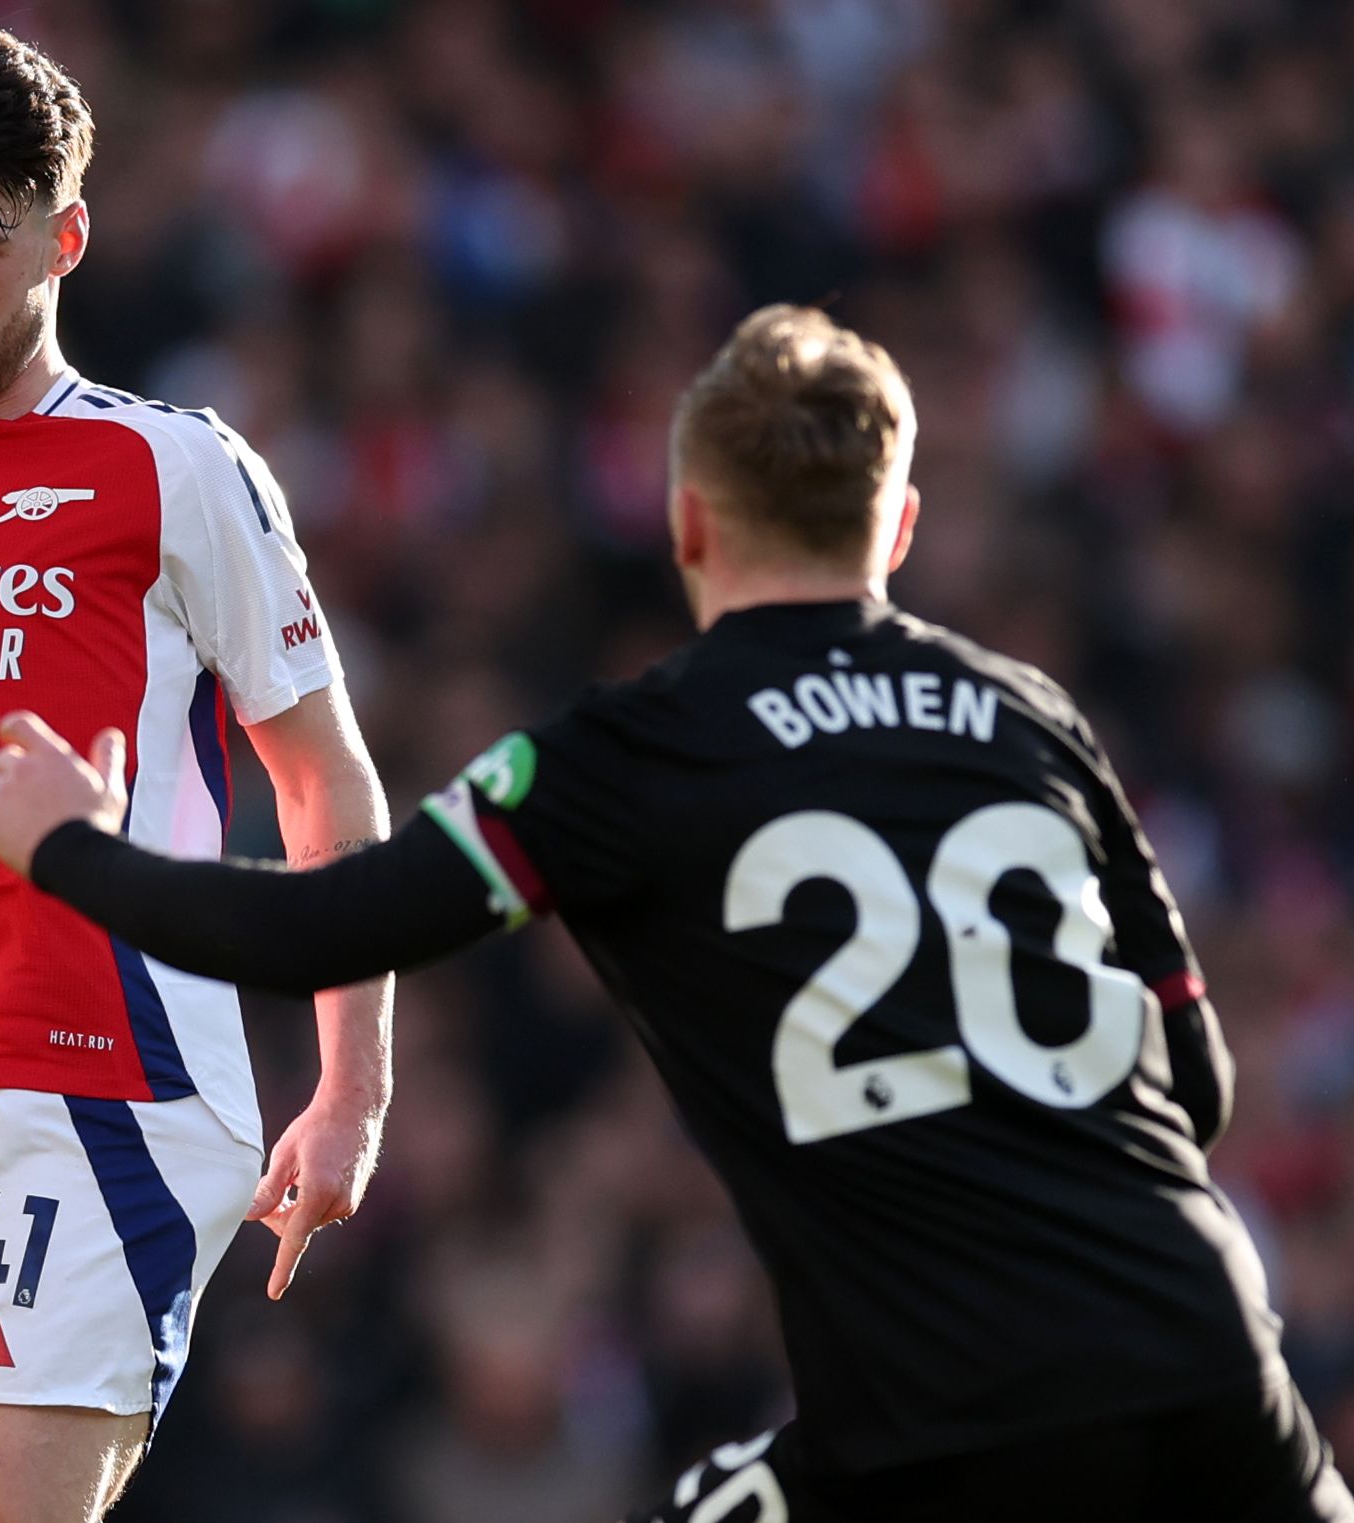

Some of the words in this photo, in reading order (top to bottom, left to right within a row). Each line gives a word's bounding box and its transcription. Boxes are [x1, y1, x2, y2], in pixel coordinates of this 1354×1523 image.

[281, 613, 322, 650] RW
[747, 671, 999, 749] BOWEN
[722, 801, 1144, 1145] 20
[49, 1029, 115, 1051] HEAT.RDY
